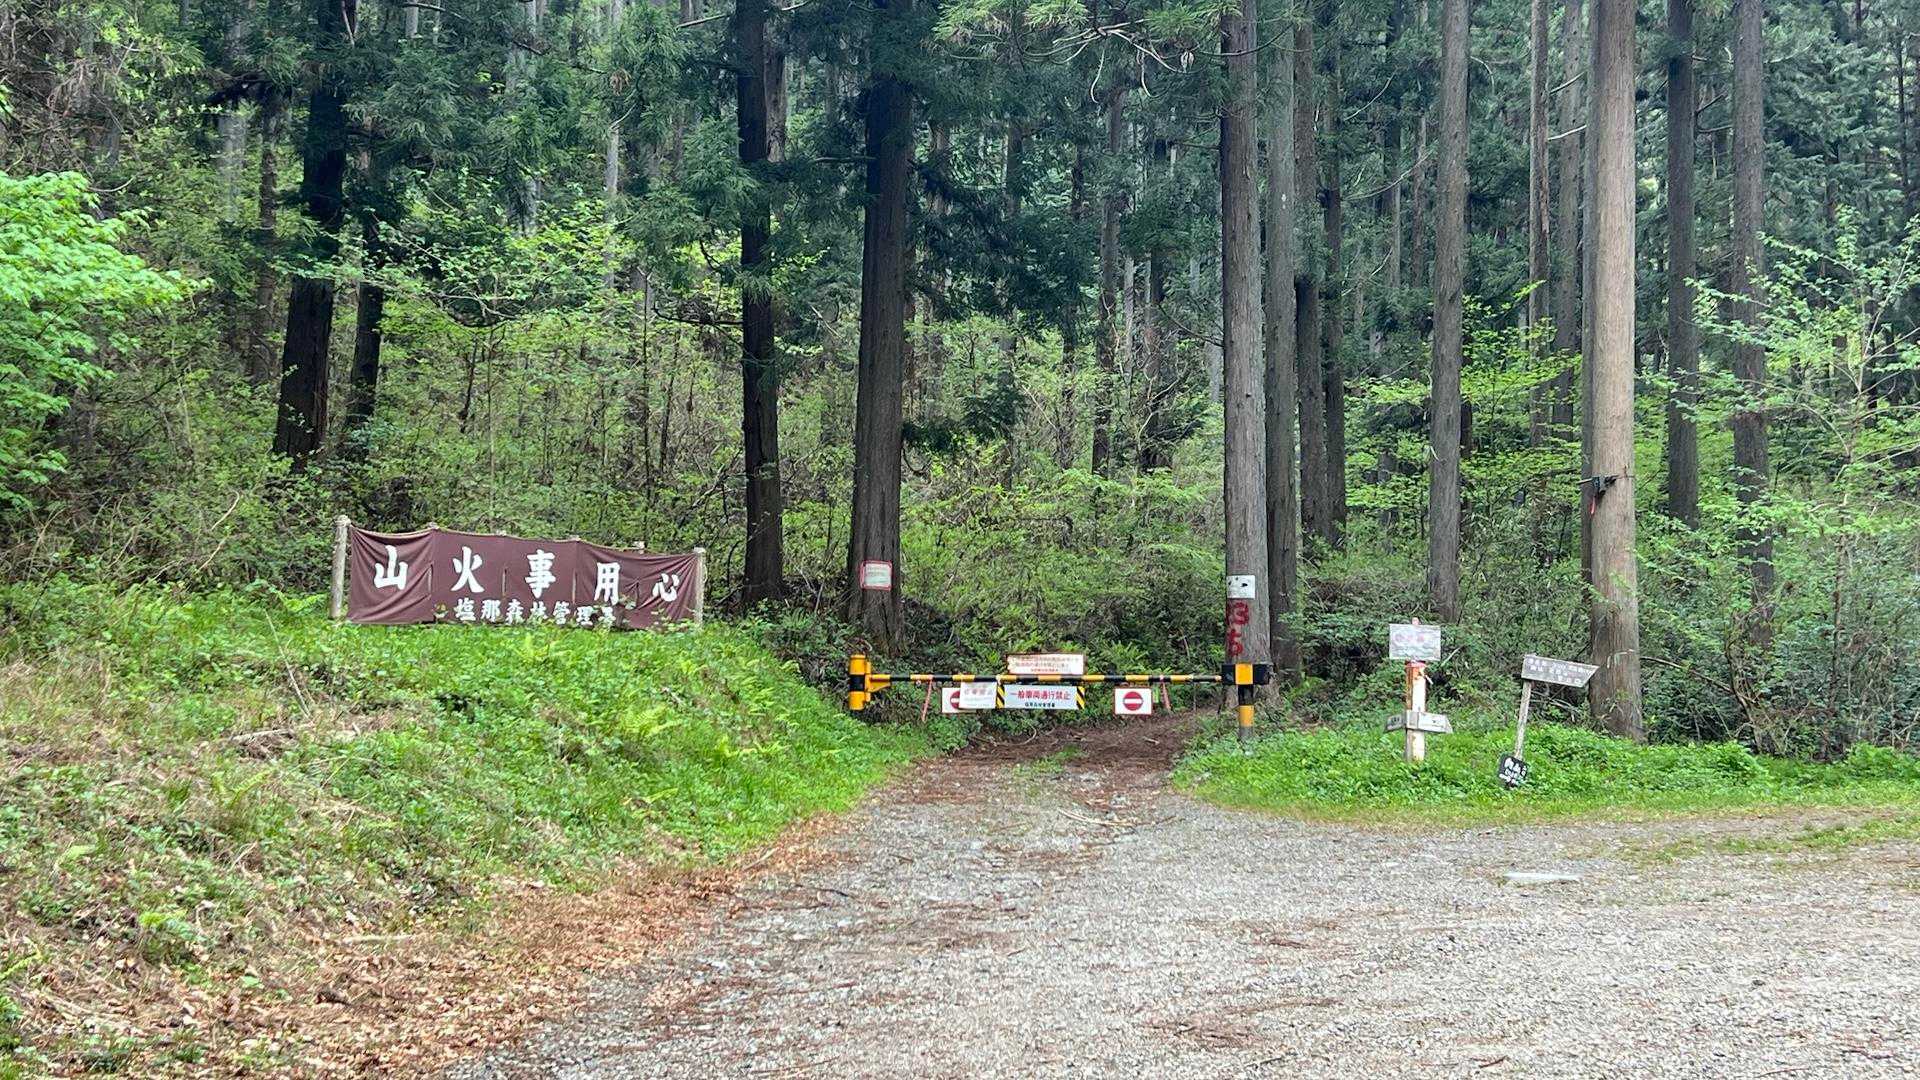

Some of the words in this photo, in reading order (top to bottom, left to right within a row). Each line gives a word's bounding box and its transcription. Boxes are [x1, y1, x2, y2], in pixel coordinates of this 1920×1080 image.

[374, 545, 680, 605] 山火事用心
